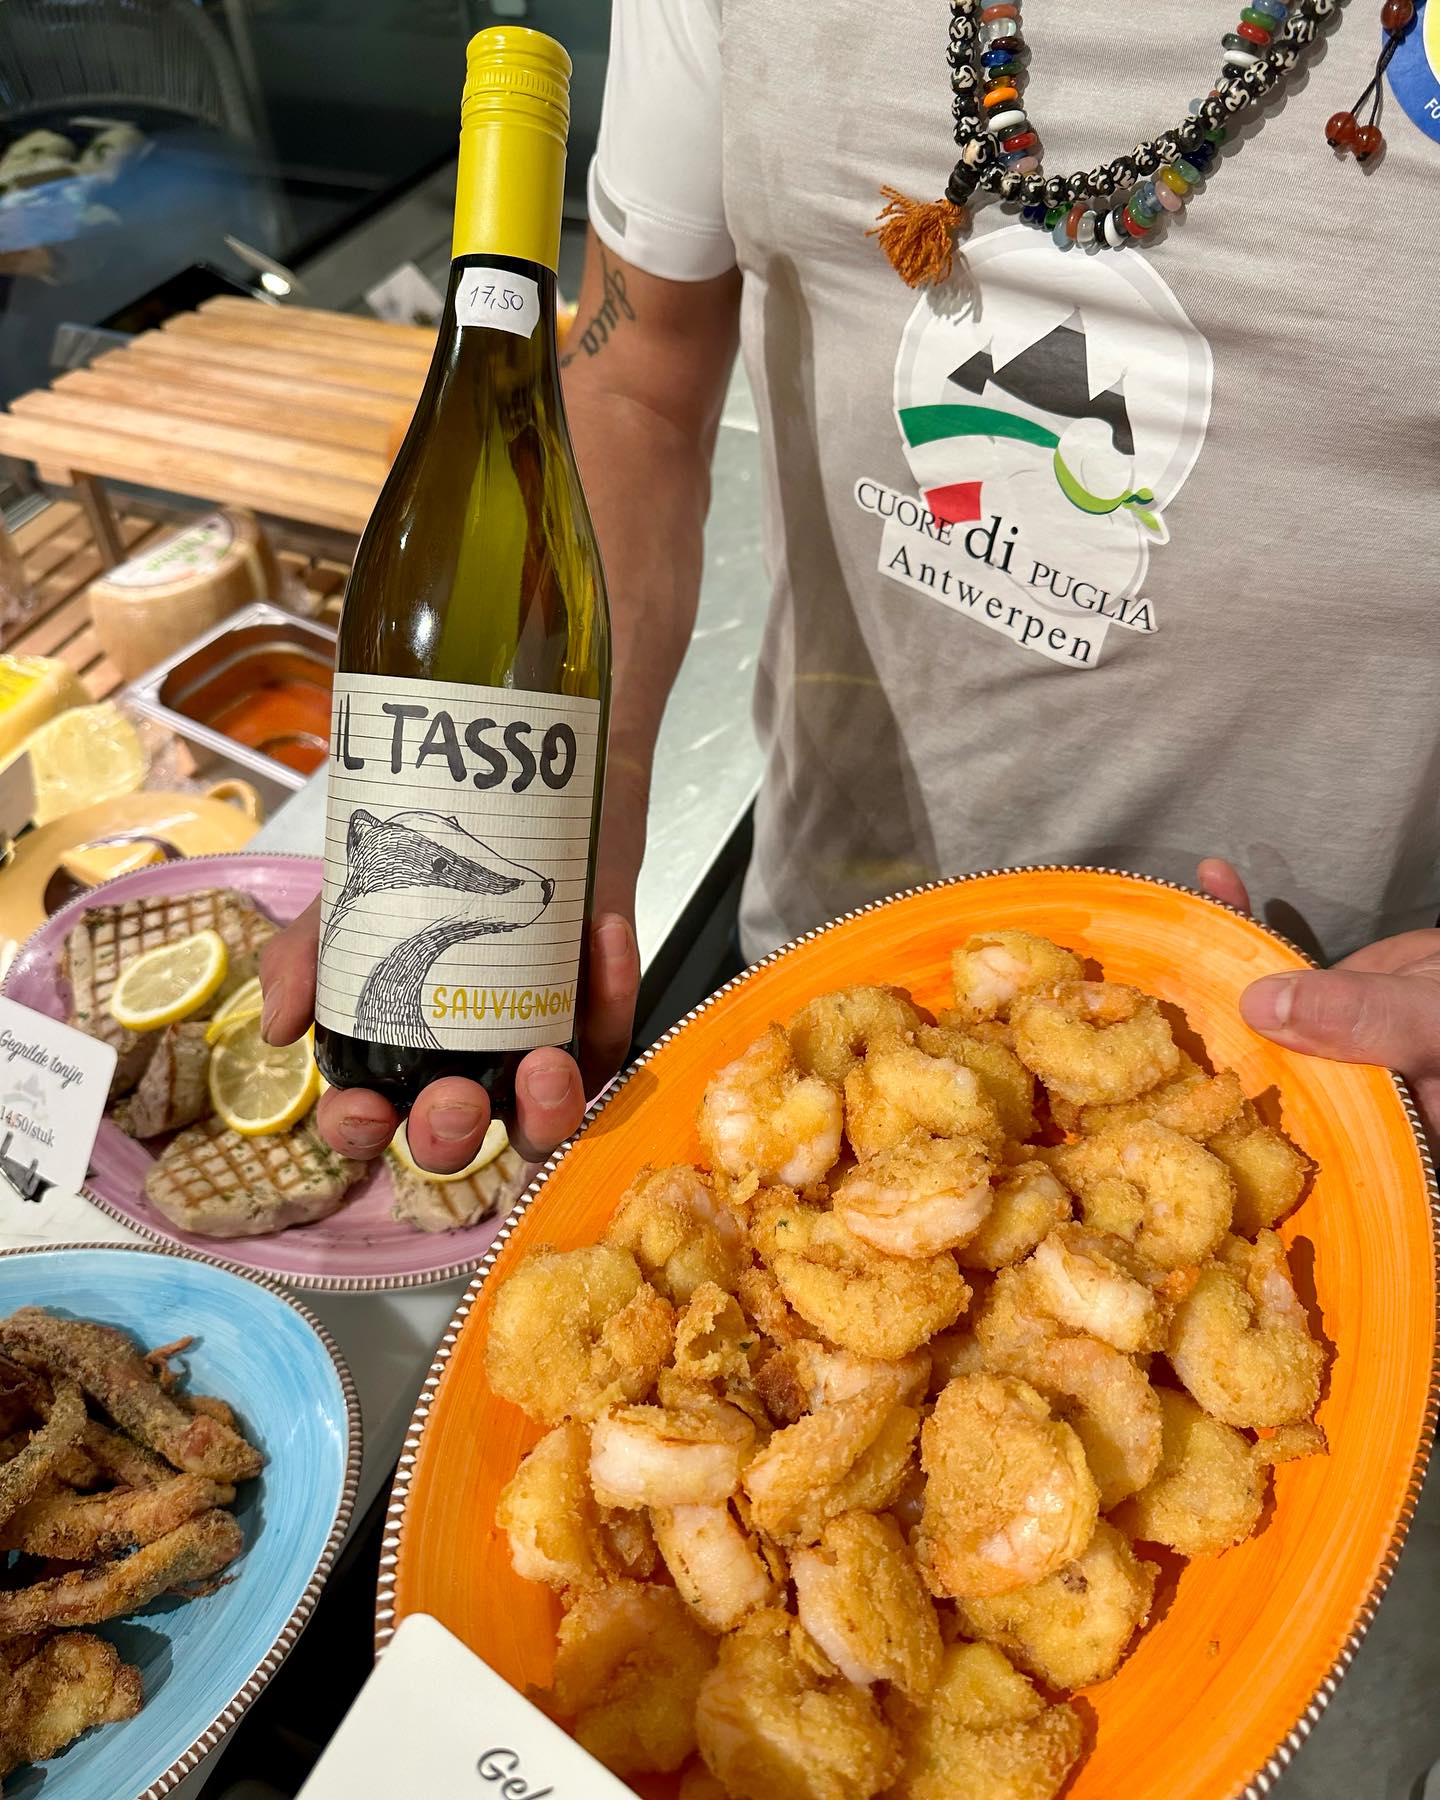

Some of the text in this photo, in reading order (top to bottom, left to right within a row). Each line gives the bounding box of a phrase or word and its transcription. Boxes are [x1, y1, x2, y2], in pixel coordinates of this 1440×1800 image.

[470, 285, 524, 311] 17,50
[858, 483, 1153, 631] CUORE di PUGLIA
[888, 544, 1093, 664] Antwerpen
[335, 692, 577, 790] IL TASSO
[432, 984, 574, 1020] SAUVIGNON
[50, 1055, 84, 1089] tonijn
